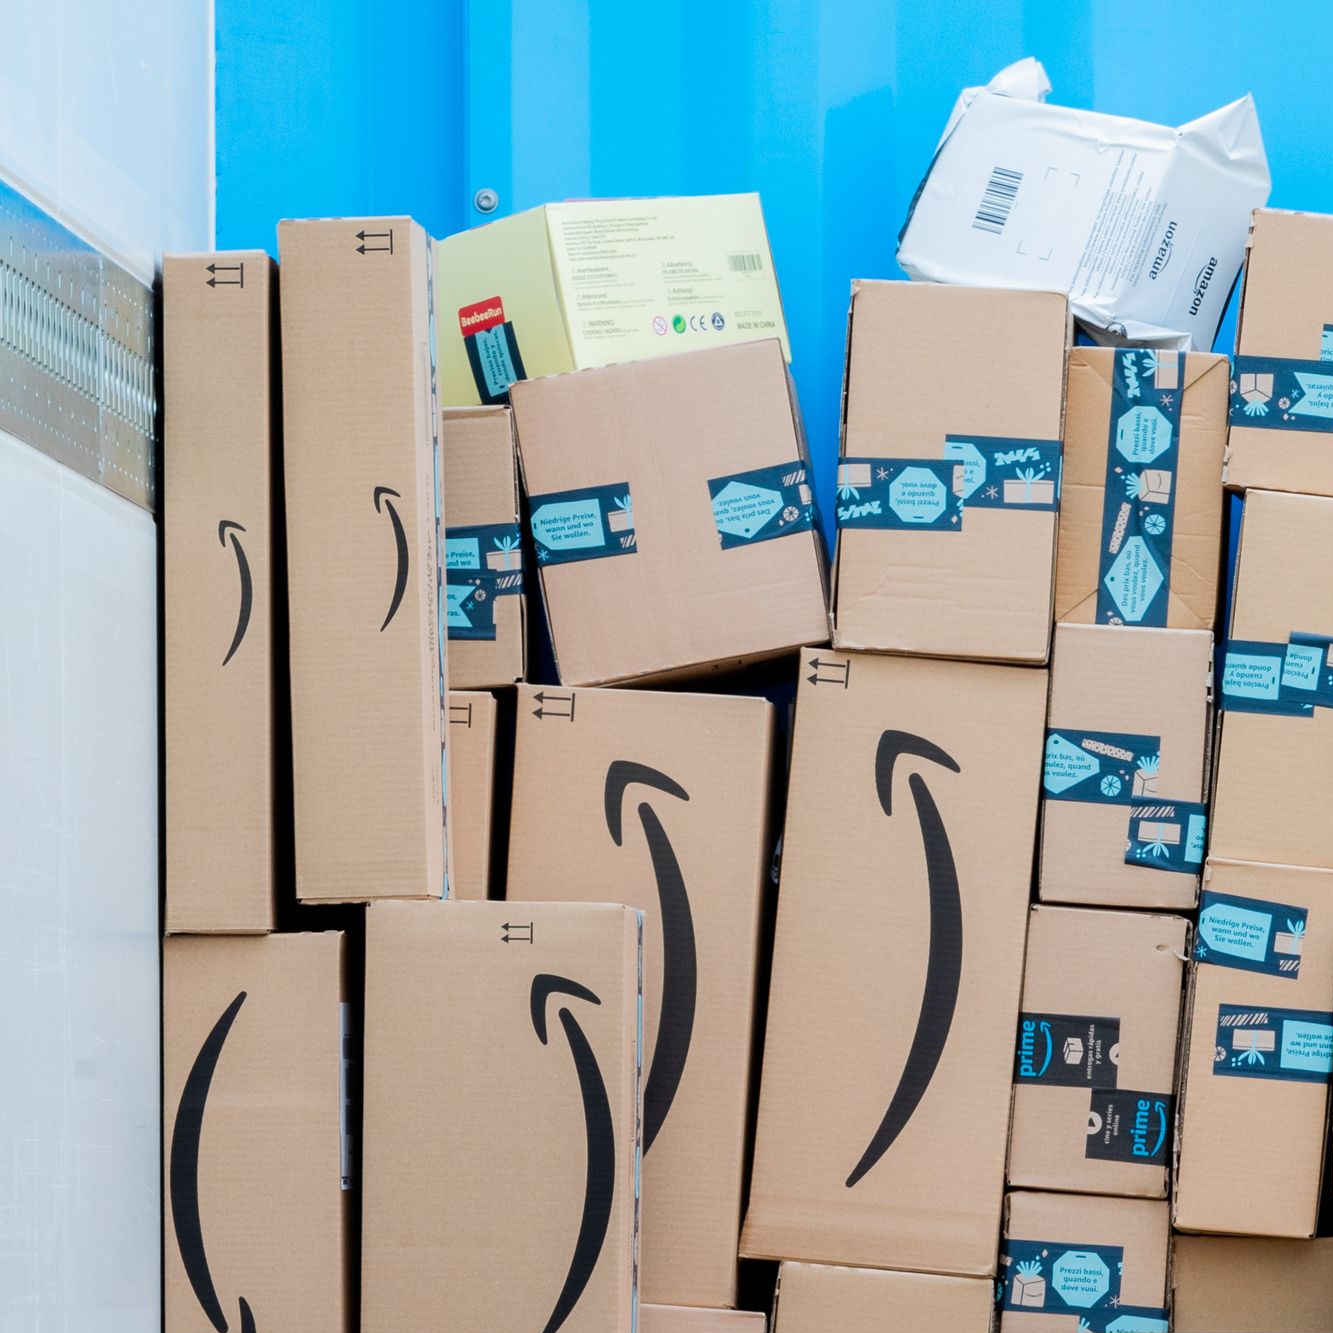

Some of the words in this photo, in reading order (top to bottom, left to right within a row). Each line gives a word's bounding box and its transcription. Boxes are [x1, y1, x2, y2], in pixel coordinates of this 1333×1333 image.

[1149, 221, 1178, 280] amazon
[1188, 256, 1218, 316] amazon
[460, 307, 502, 327] BeebeeRun
[737, 322, 753, 330] MADE
[760, 321, 776, 329] CHINA
[1132, 411, 1142, 432] bassi,
[1150, 416, 1159, 435] vuoi.
[1131, 433, 1140, 456] Prezzi
[1140, 423, 1149, 452] quando
[1147, 435, 1156, 454] dove
[539, 515, 571, 526] Niedrige
[571, 512, 597, 521] Preise,
[544, 525, 566, 534] wann
[566, 521, 582, 531] und
[550, 533, 562, 541] Sie
[562, 530, 591, 539] wollen.
[1208, 915, 1240, 929] Niedrige
[1240, 921, 1265, 933] Preise,
[1211, 926, 1232, 935] wann
[1232, 930, 1248, 938] und
[1248, 932, 1260, 940] wo
[1213, 933, 1226, 943] Sie
[1226, 937, 1253, 948] wollen.
[1086, 1023, 1095, 1049] rápidas
[1017, 1019, 1040, 1077] prime
[1094, 1039, 1102, 1059] gratis
[1086, 1049, 1094, 1079] entregas
[1105, 1103, 1113, 1124] series
[1112, 1114, 1120, 1136] online
[1129, 1098, 1151, 1157] prime
[1103, 1129, 1111, 1144] cine
